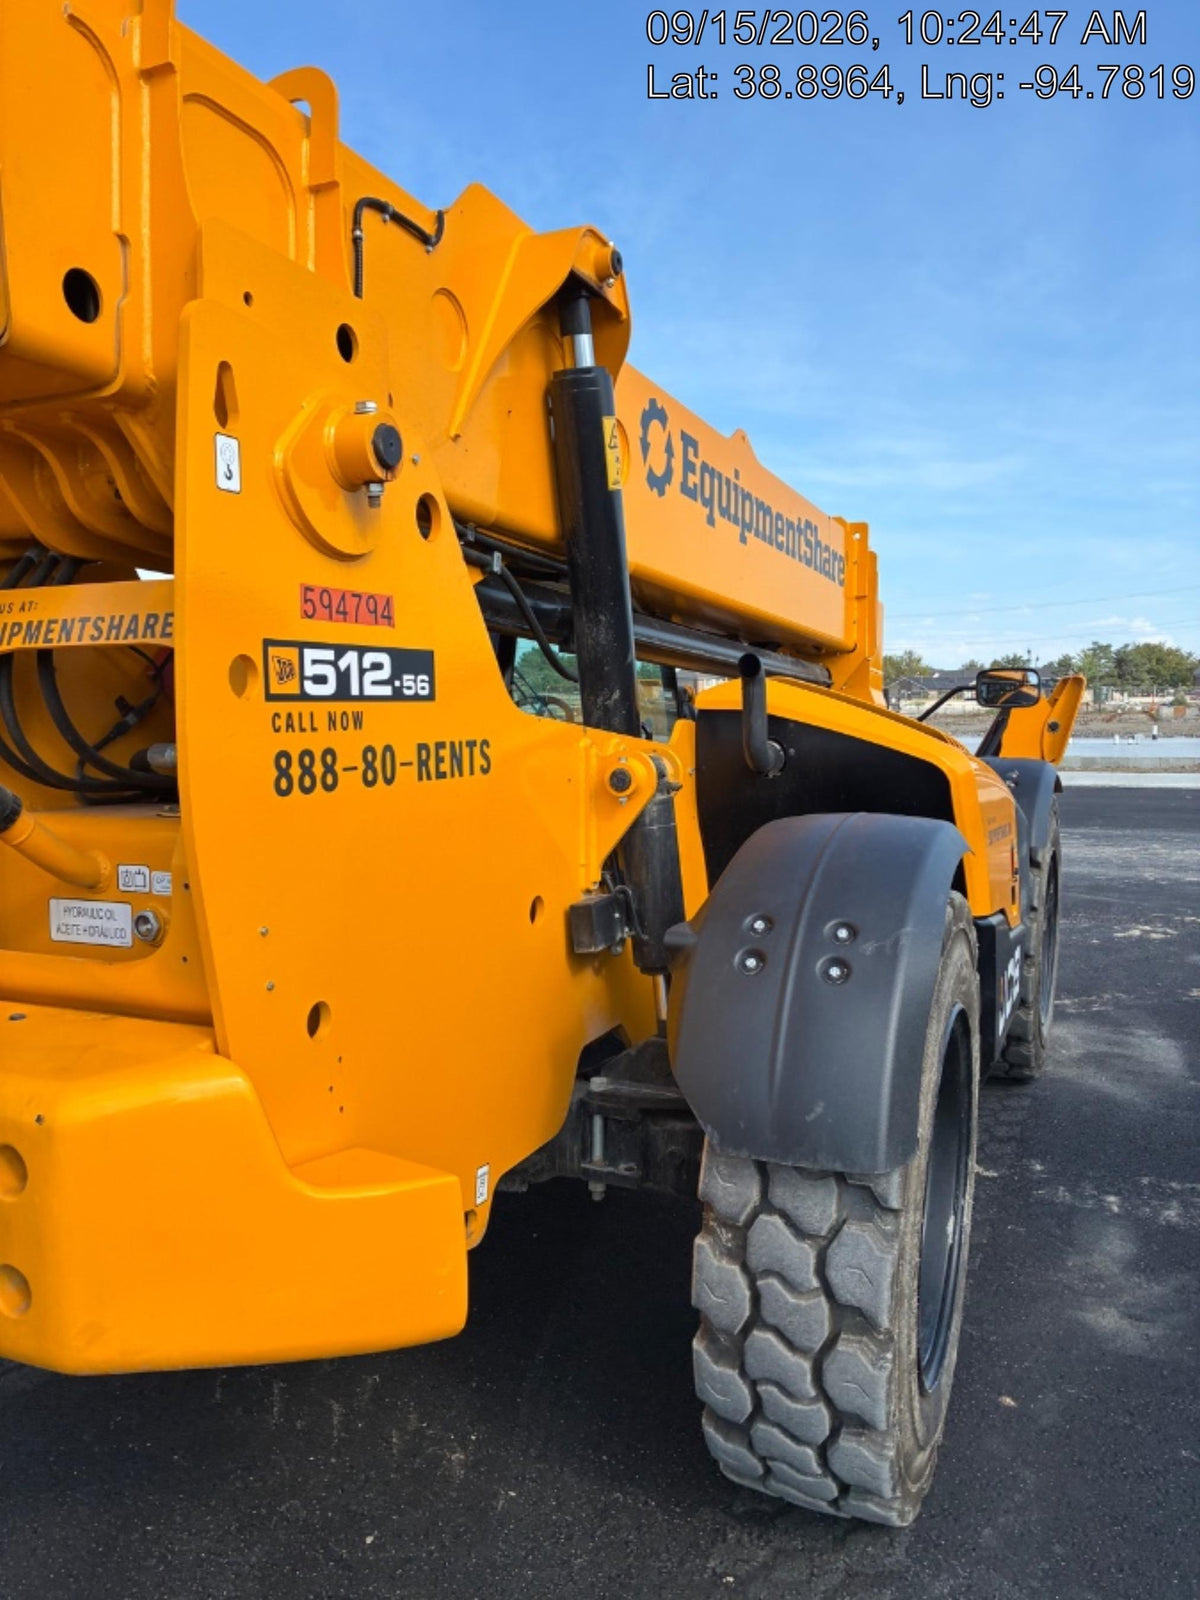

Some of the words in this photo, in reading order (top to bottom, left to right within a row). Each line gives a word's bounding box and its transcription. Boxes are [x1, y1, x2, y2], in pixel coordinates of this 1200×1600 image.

[680, 429, 846, 587] EquipmentShare
[19, 600, 39, 613] AT:
[303, 586, 393, 626] 594794
[271, 711, 318, 733] CALL
[328, 710, 364, 731] NOW
[273, 738, 492, 797] 888-80-RENTS
